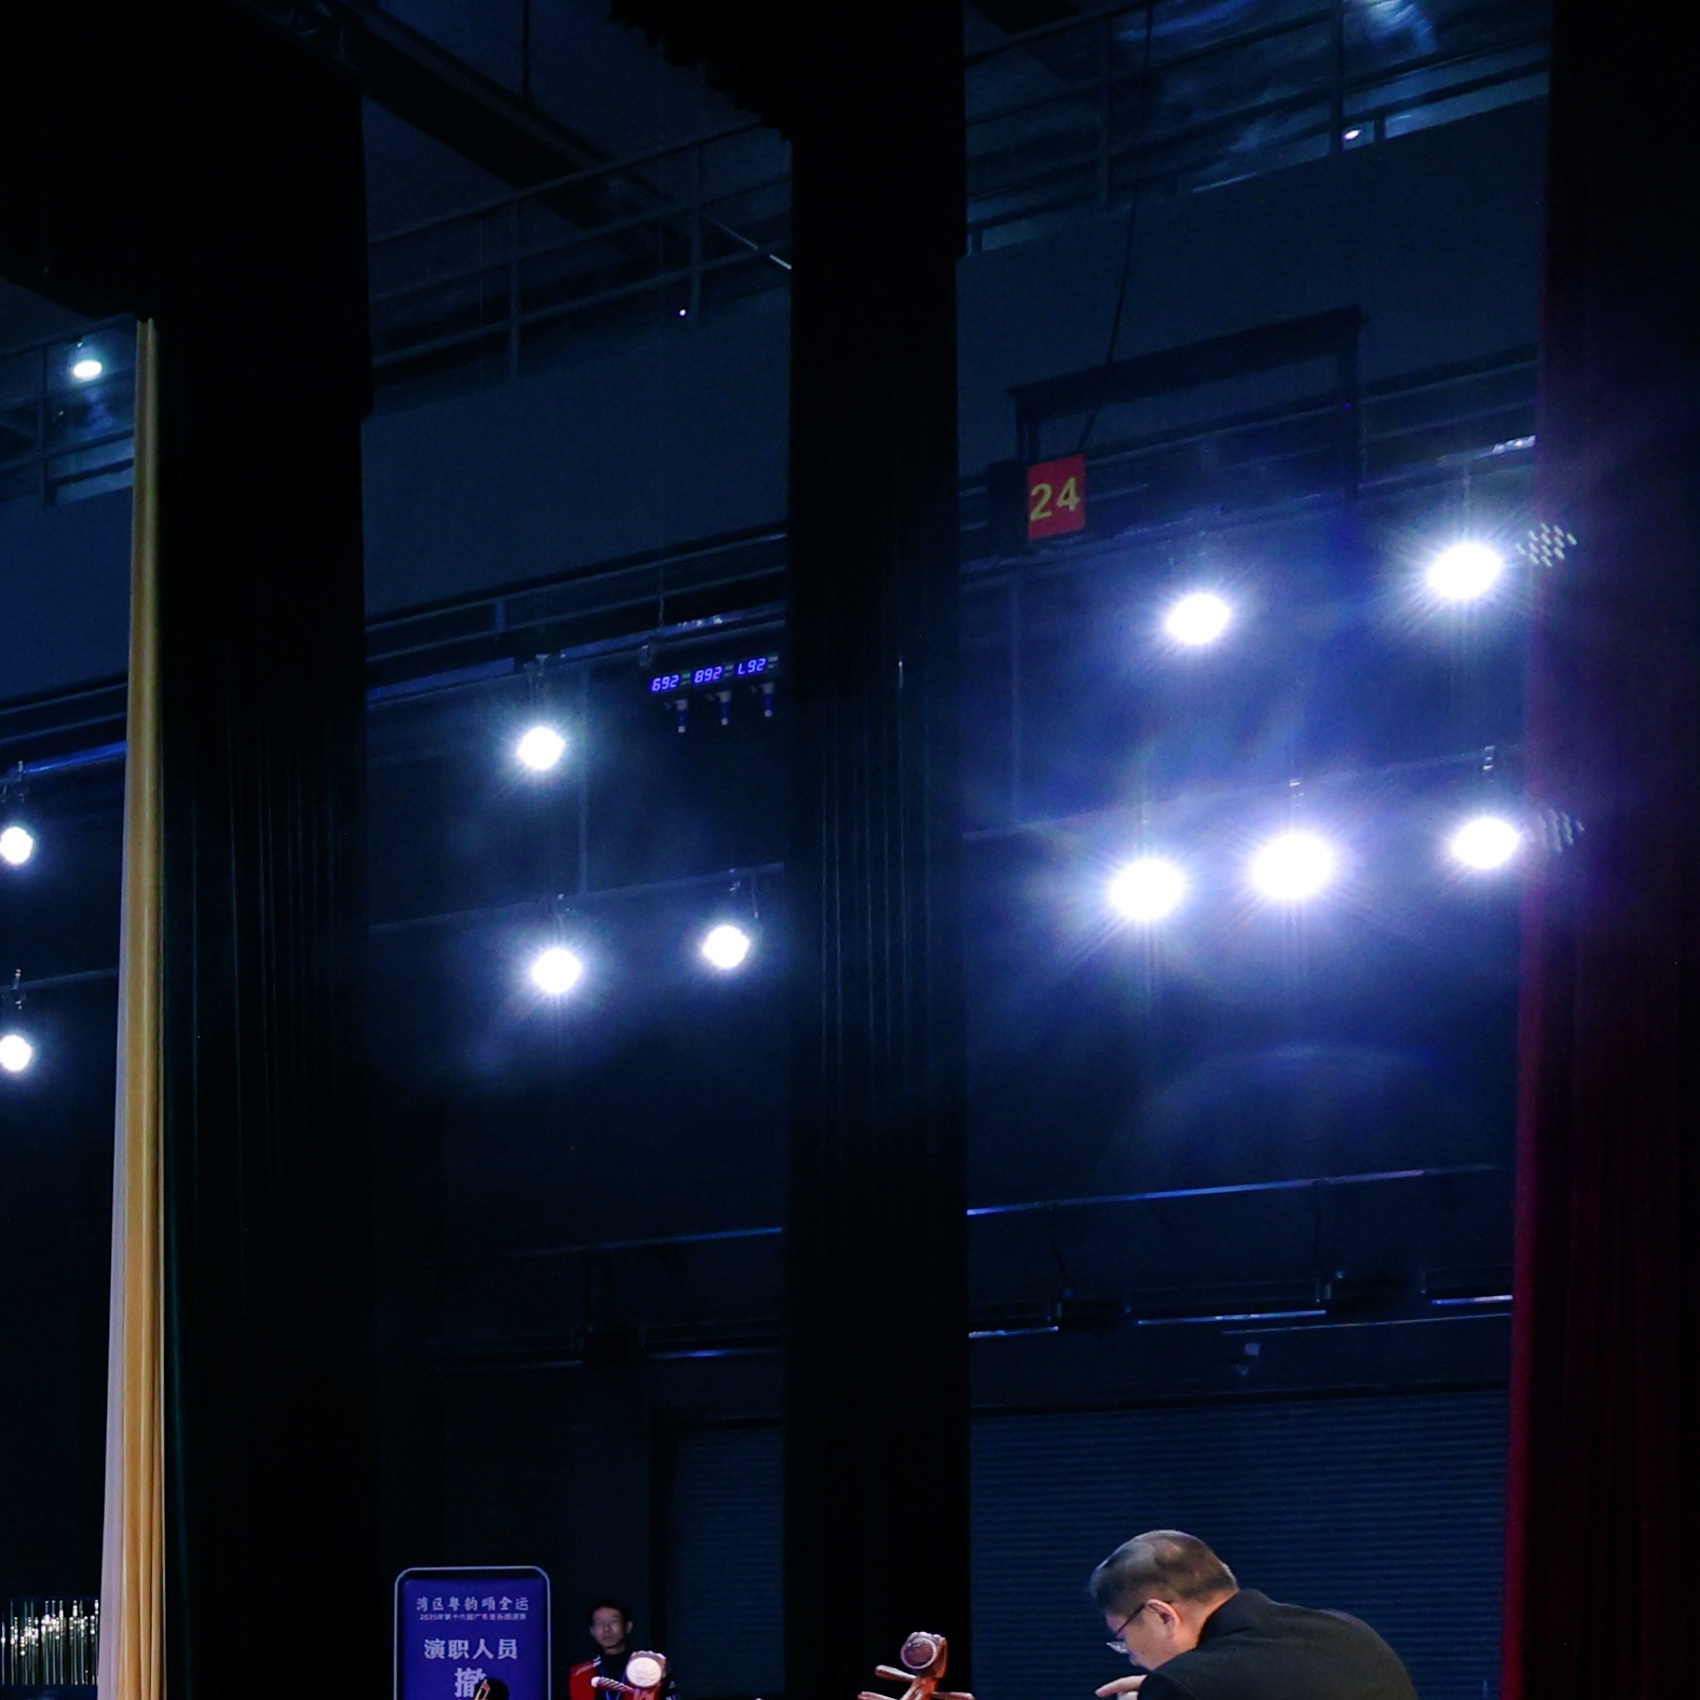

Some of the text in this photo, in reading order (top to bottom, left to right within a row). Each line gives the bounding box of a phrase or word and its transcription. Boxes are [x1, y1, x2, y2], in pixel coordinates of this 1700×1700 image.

[1030, 476, 1081, 522] 24
[424, 1638, 518, 1660] 演职人员
